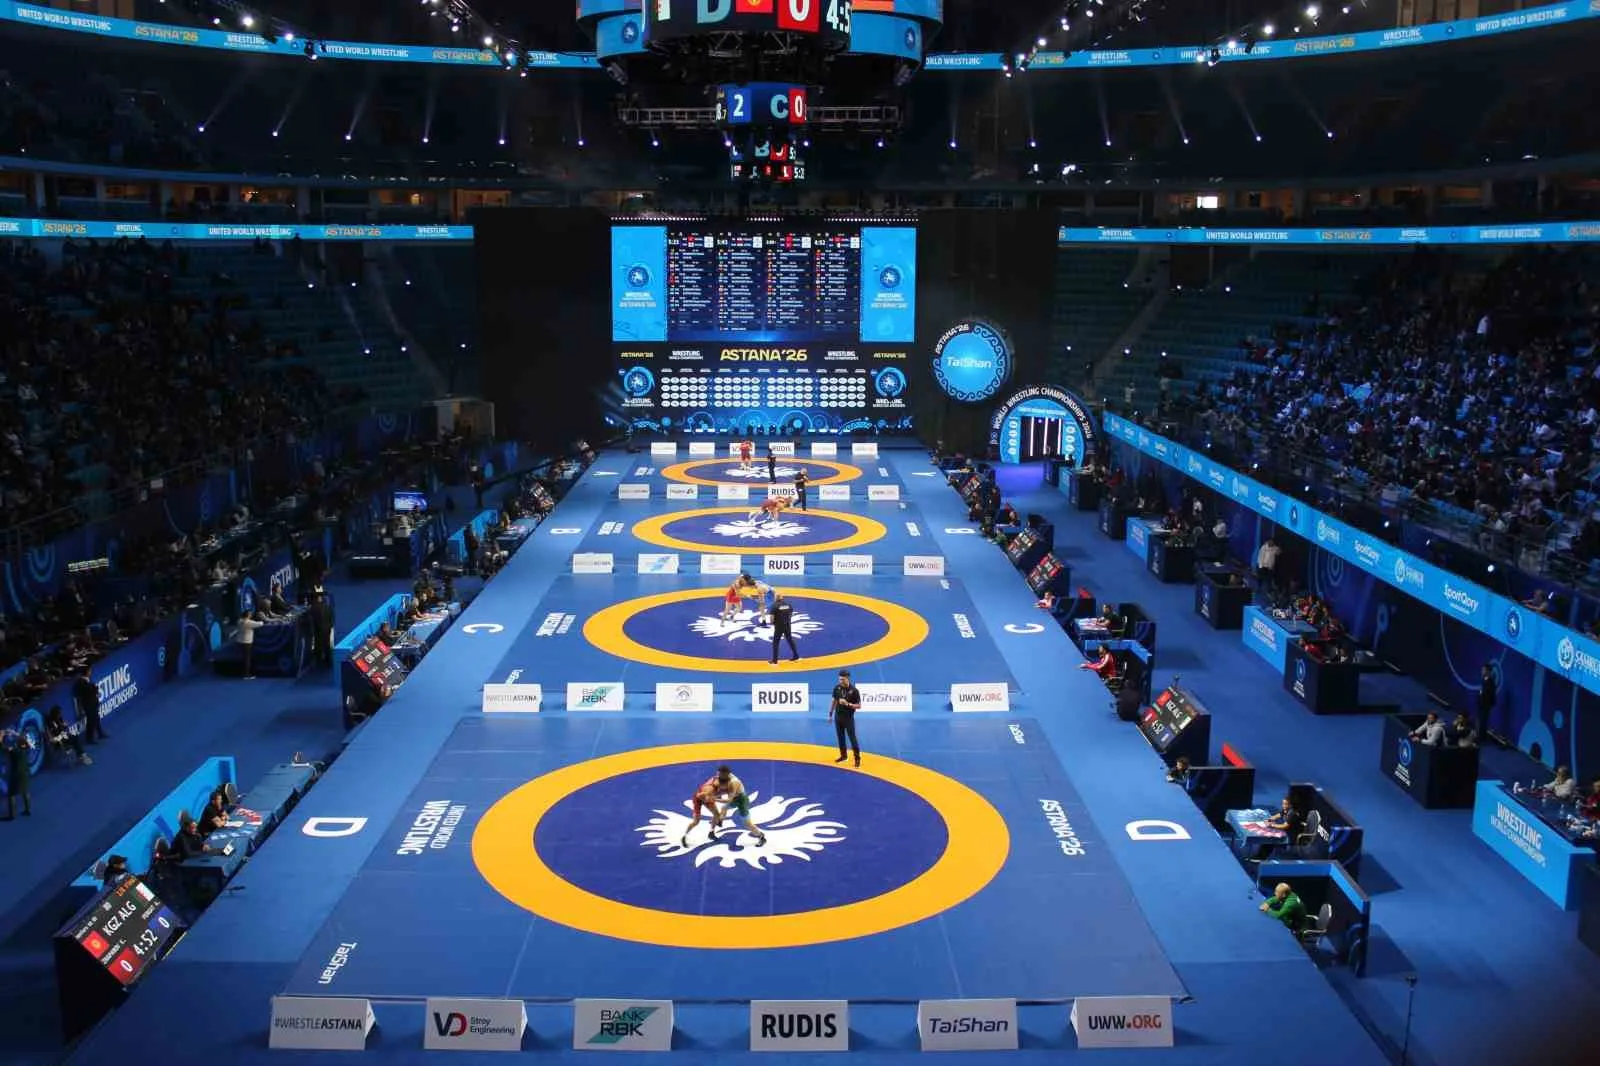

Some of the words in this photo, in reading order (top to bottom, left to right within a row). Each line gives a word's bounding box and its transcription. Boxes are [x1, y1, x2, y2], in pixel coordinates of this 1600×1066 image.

[17, 8, 42, 21] UNITED
[43, 13, 69, 26] WORLD
[71, 17, 111, 31] WRESTLING
[1475, 20, 1500, 32] UNITED
[1501, 15, 1525, 29] WORLD
[1527, 8, 1567, 25] WRESTLING
[135, 22, 198, 42] ASTANA'26
[345, 46, 370, 55] WORLD
[371, 47, 409, 57] WRESTLING
[733, 94, 744, 117] 2
[770, 94, 788, 119] C
[795, 95, 803, 118] 0
[1206, 232, 1229, 240] UNITED
[1230, 232, 1252, 240] WORLD
[935, 323, 970, 354] ASTANA'26
[720, 349, 808, 361] ASTANA'26
[947, 356, 992, 369] TaiShan
[1007, 387, 1040, 407] WRESTLING
[768, 560, 800, 570] RUDIS
[462, 623, 504, 634] C
[1004, 623, 1045, 634] C
[582, 695, 607, 703] RBK
[758, 691, 802, 705] RUDIS
[862, 693, 907, 703] TaiShan
[959, 692, 1002, 702] UWW.ORG
[443, 805, 467, 827] UNITED
[1497, 801, 1543, 849] WRESTLING
[302, 817, 368, 837] D
[396, 800, 451, 855] WRESTLING
[1125, 820, 1192, 840] D
[430, 826, 457, 849] WORLD
[102, 916, 122, 936] KGZ
[118, 900, 137, 921] ALG
[158, 916, 170, 929] 0
[133, 928, 158, 956] 4:52
[120, 959, 133, 972] 0
[318, 942, 357, 984] TaiShan
[600, 1010, 645, 1021] BANK
[1088, 1014, 1161, 1031] UWW.ORG
[469, 1026, 516, 1036] Engineering
[600, 1022, 644, 1036] RBK
[762, 1013, 837, 1038] RUDIS
[929, 1017, 1009, 1033] TaiShan
